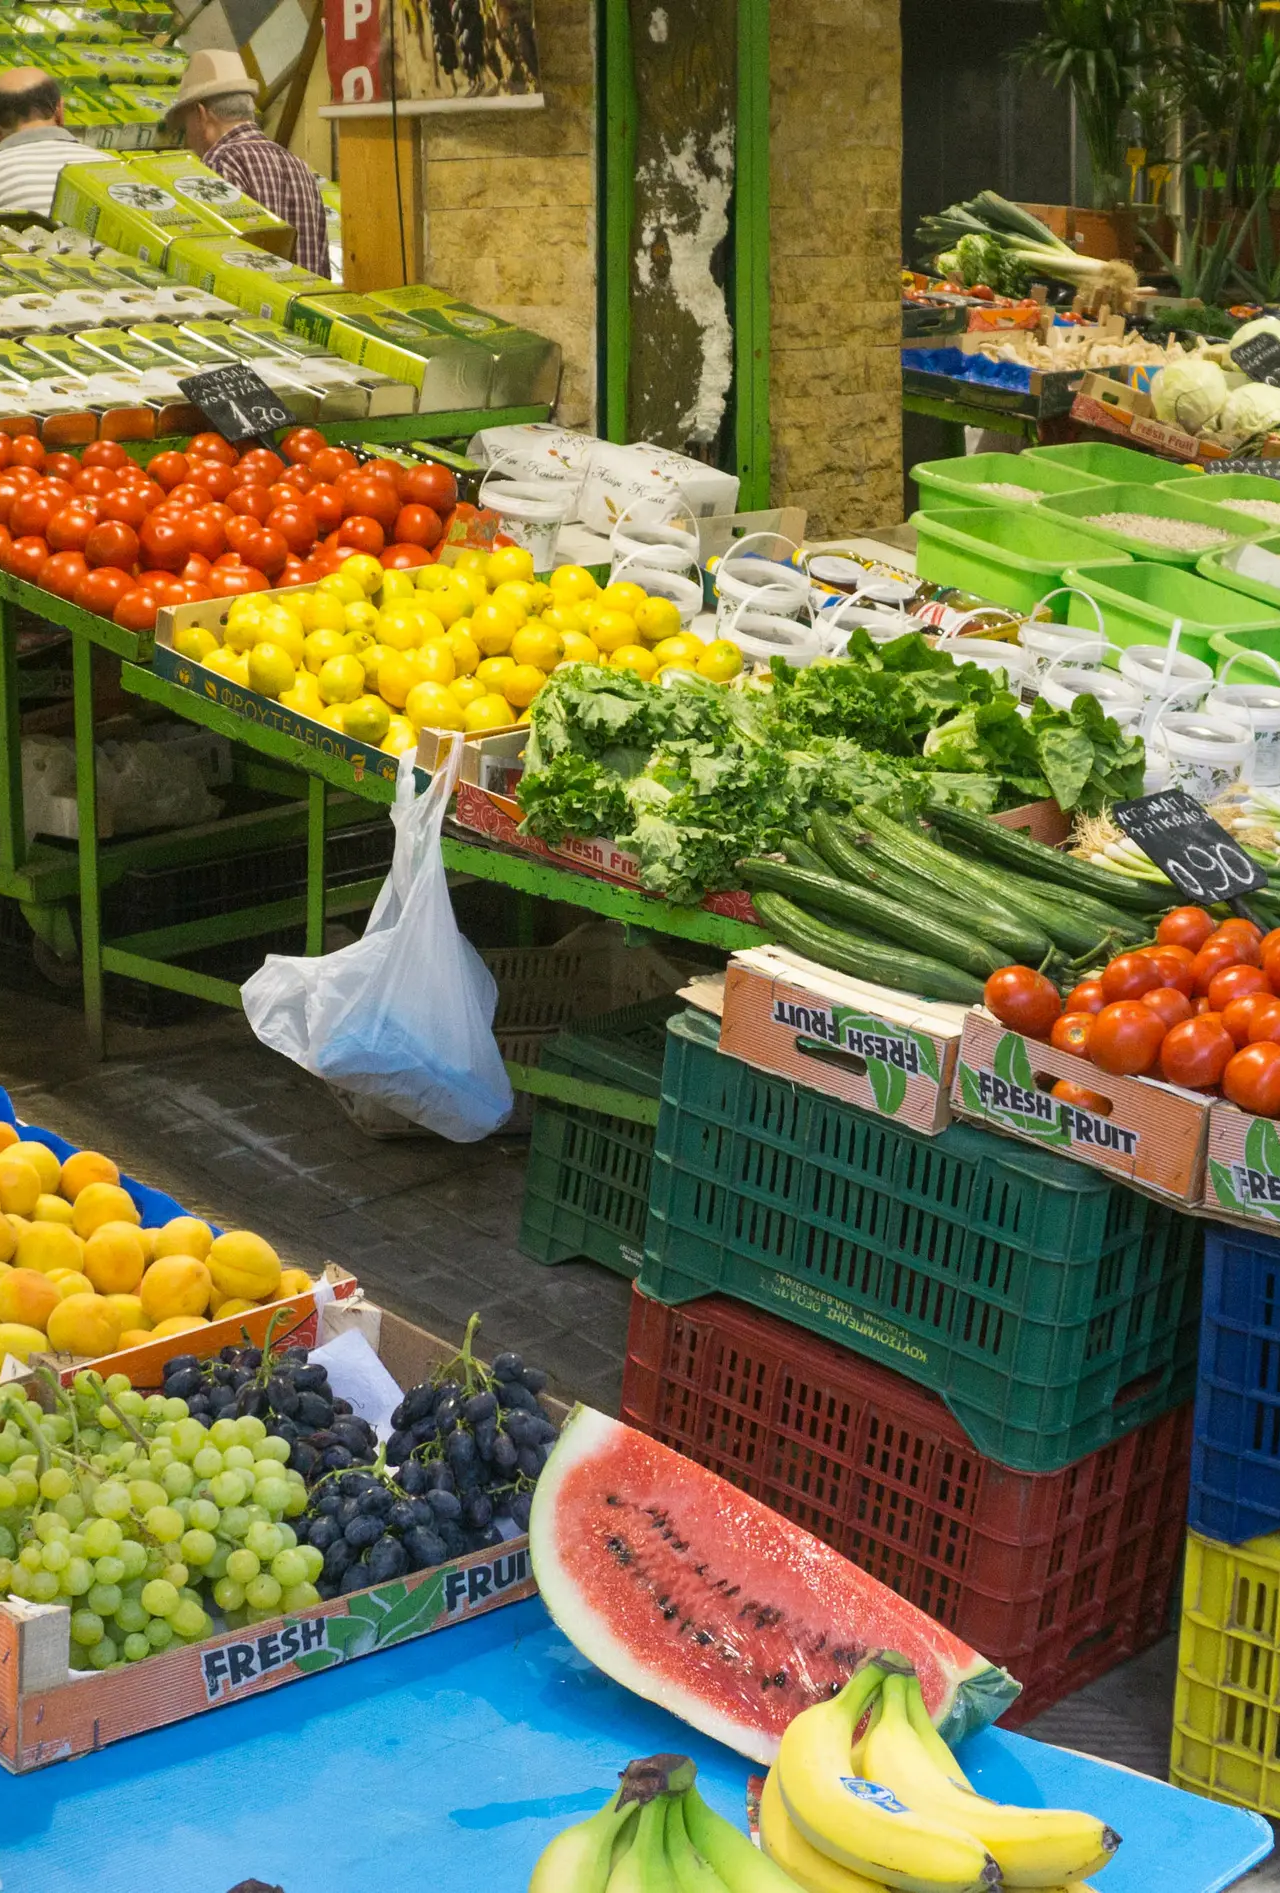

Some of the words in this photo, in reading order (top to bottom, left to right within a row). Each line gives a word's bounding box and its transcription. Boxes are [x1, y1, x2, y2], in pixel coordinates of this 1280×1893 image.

[565, 836, 604, 866] resh
[610, 851, 640, 878] Fru
[774, 1001, 841, 1045] FRUIT
[847, 1029, 920, 1075] FRESH
[979, 1071, 1053, 1121] FRESH
[1060, 1104, 1138, 1154] FRUIT
[203, 1617, 327, 1698] FRESH
